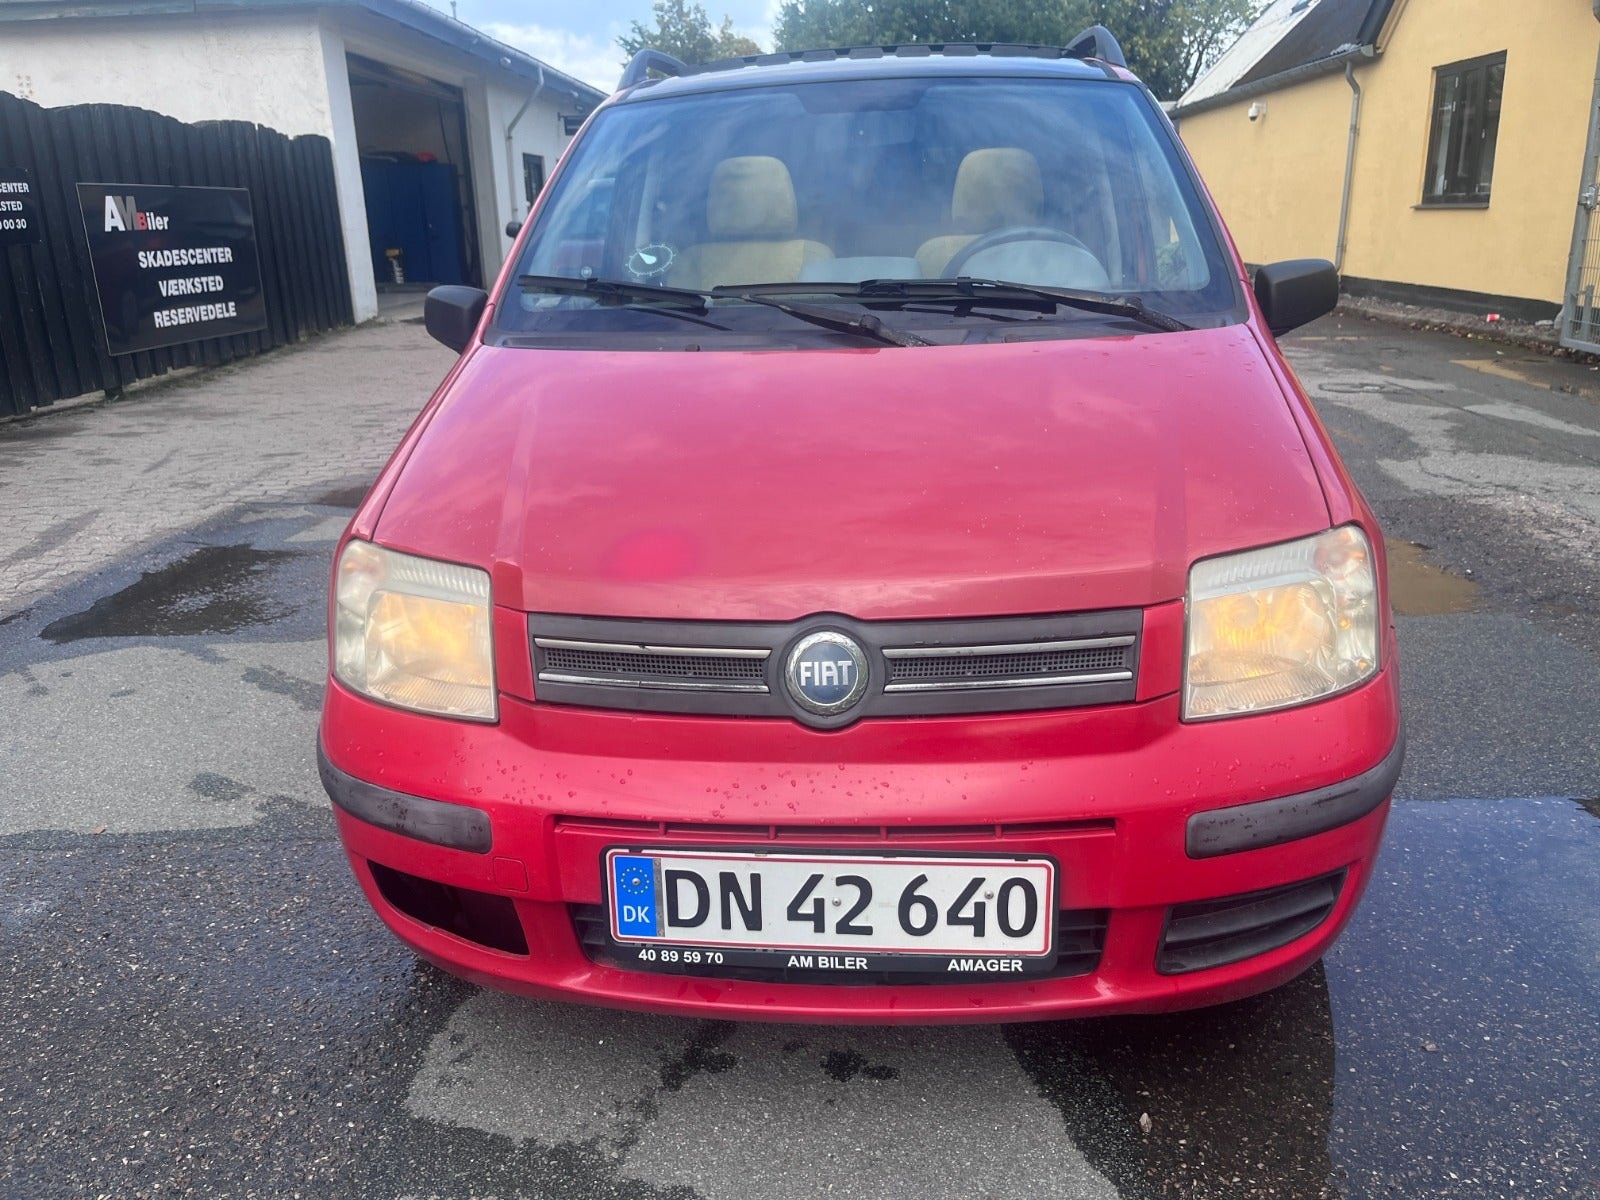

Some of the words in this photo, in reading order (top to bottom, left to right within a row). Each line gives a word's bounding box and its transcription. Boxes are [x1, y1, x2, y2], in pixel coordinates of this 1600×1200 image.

[0, 182, 29, 193] ENTER
[0, 200, 23, 211] STED
[15, 218, 27, 229] 30
[138, 246, 233, 268] SKADESCENTER
[158, 275, 224, 297] VÆRKSTED
[153, 301, 237, 328] RESERVEDELE
[800, 660, 852, 686] FIAT
[665, 869, 762, 931] DN
[786, 873, 873, 936] 42
[898, 873, 1038, 938] 640
[623, 905, 651, 923] DK
[638, 949, 656, 961] 40
[660, 950, 679, 962] 89
[683, 951, 701, 963] 59
[705, 952, 724, 964] 70
[787, 955, 813, 968] AM
[818, 956, 868, 970] BILER
[947, 959, 1023, 972] AMAGER
